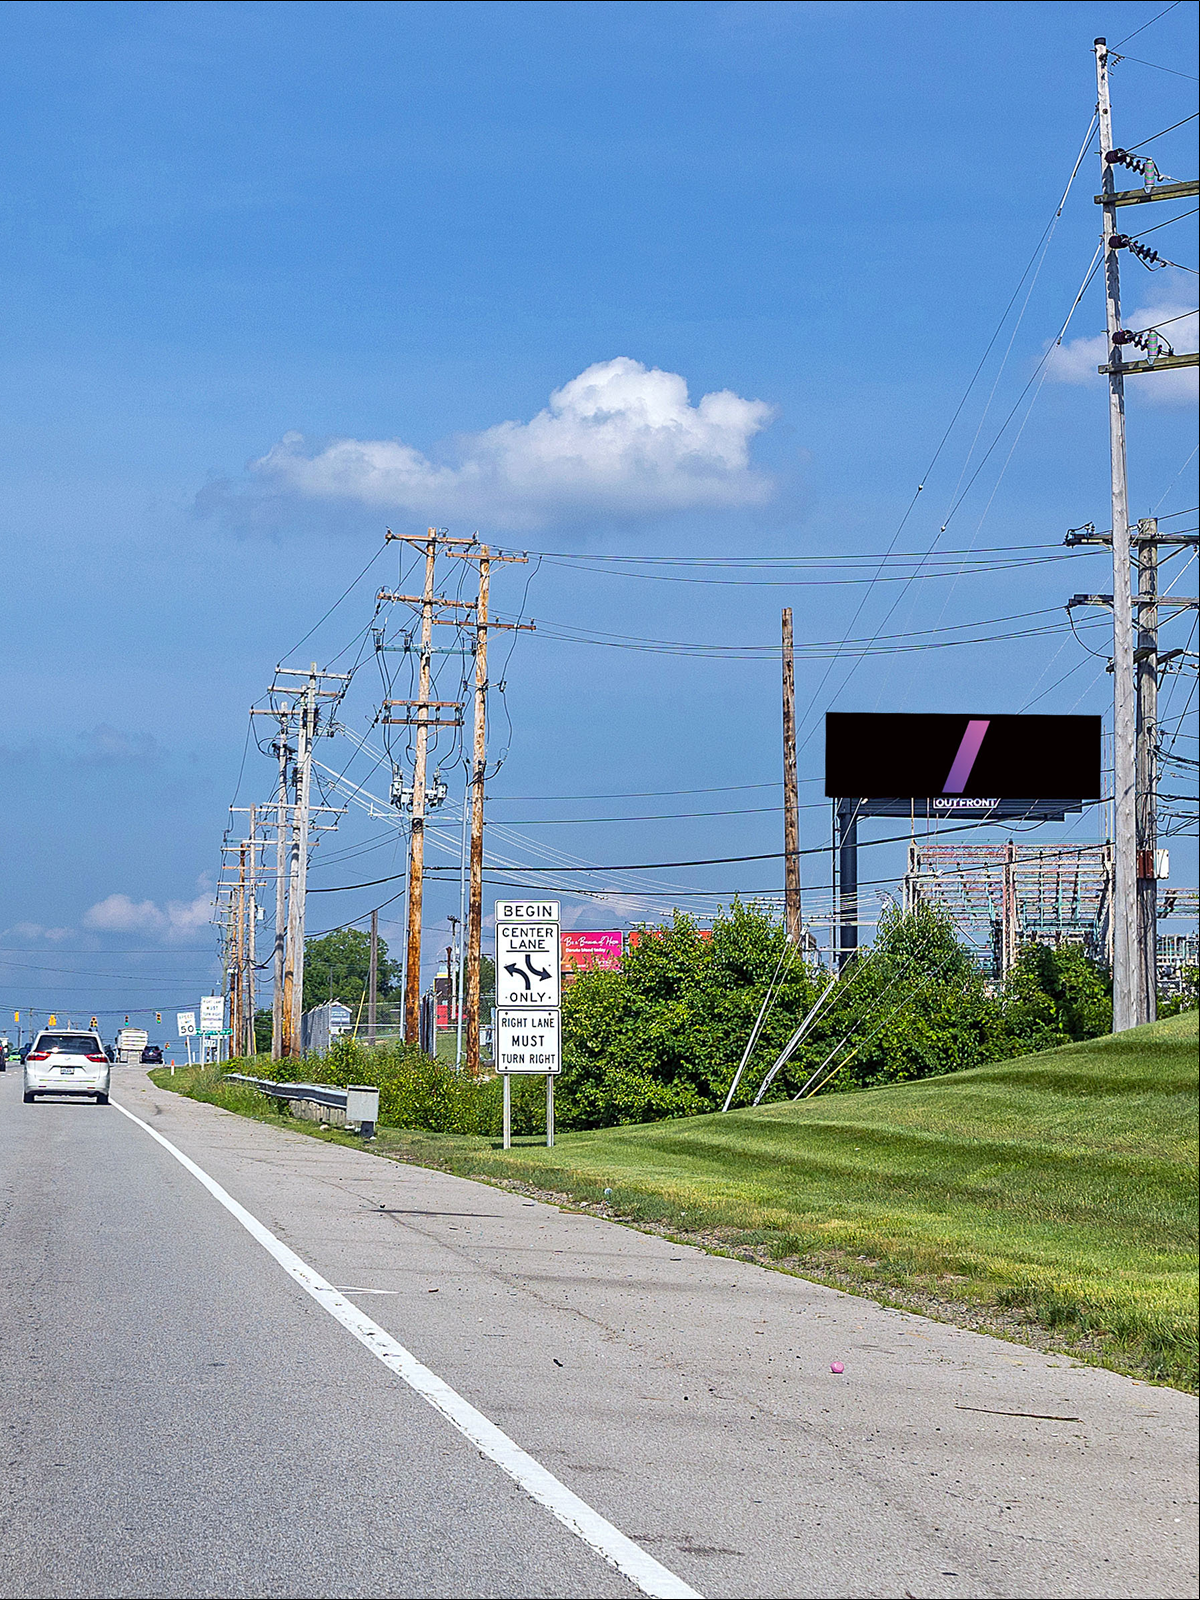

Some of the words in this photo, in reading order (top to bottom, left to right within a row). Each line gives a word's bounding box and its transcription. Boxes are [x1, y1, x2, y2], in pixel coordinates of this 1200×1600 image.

[935, 798, 997, 807] OUTFRONT
[503, 905, 552, 917] BEGIN
[502, 927, 553, 938] CENTER
[510, 940, 545, 949] LANE
[510, 992, 546, 1002] ONLY
[501, 1017, 528, 1028] RIGHT
[531, 1018, 555, 1028] LANE
[181, 1025, 194, 1033] 50
[512, 1035, 545, 1047] MUST
[501, 1053, 525, 1064] TURN
[529, 1053, 556, 1064] RIGHT
